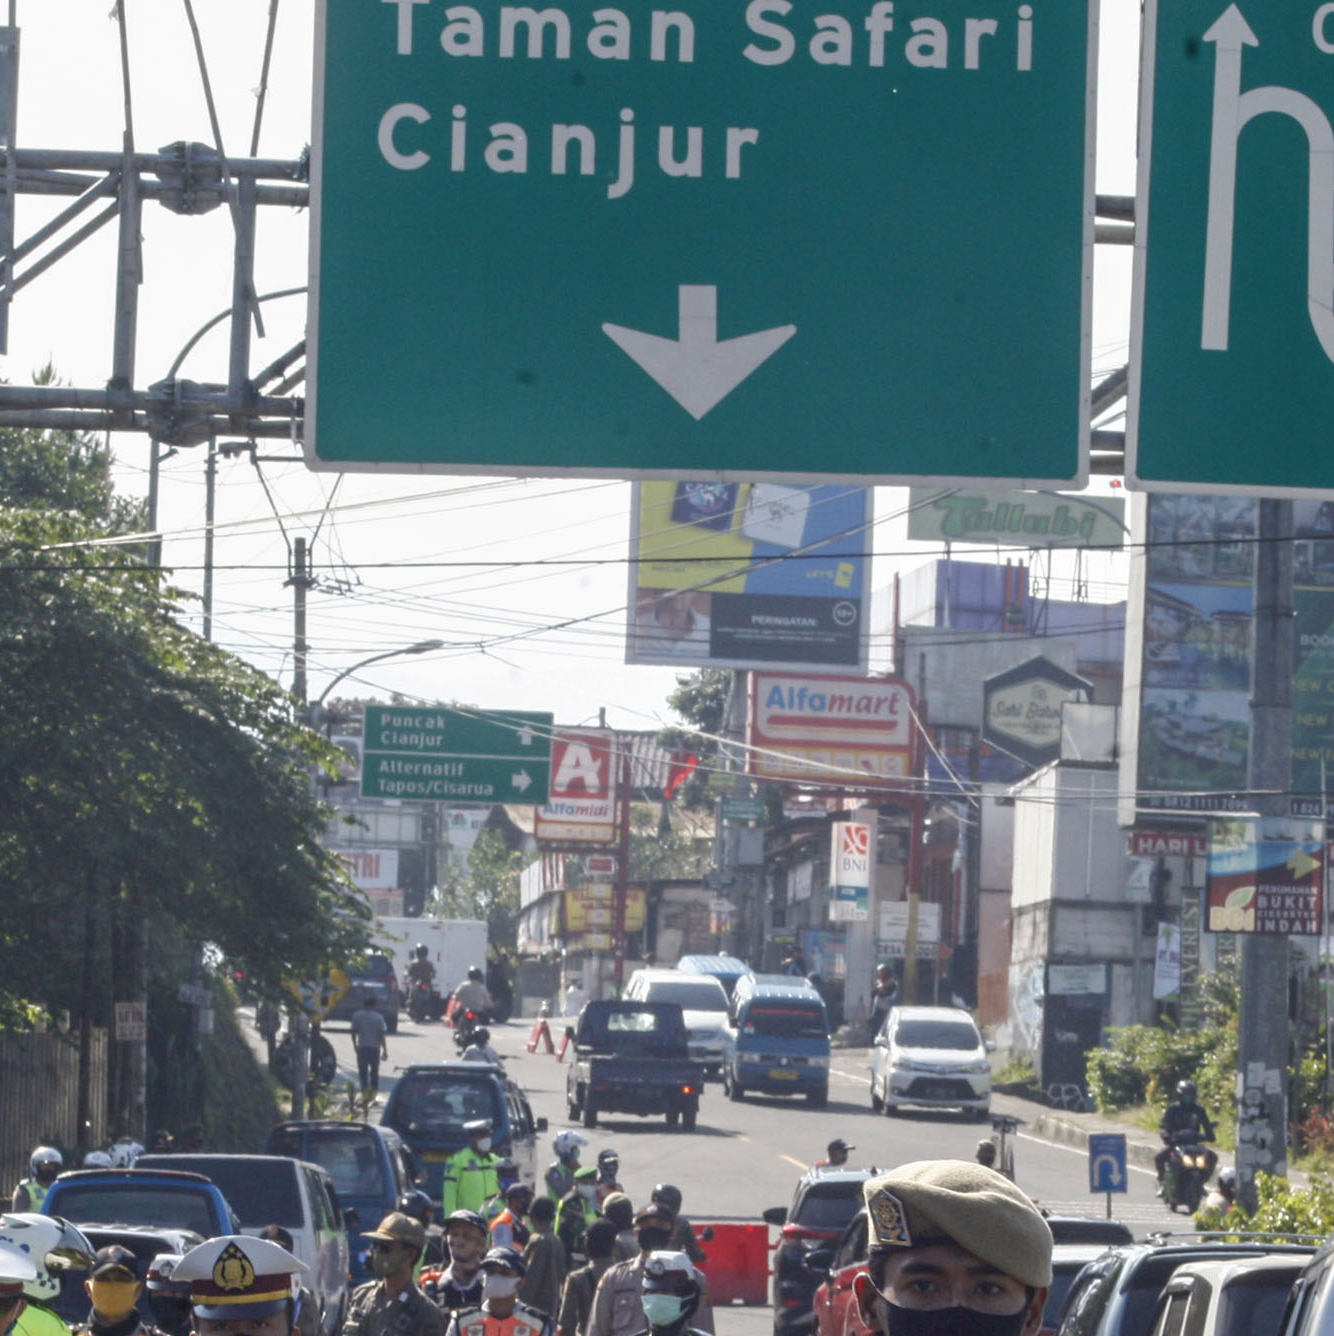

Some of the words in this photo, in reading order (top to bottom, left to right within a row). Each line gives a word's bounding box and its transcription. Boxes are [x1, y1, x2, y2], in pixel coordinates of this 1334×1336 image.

[381, 0, 697, 64] Taman
[742, 0, 1034, 72] Safari
[377, 102, 760, 200] Cianjur
[766, 684, 901, 718] Alfamart
[380, 713, 445, 730] Puncak
[380, 730, 444, 749] Cianjur
[378, 759, 466, 777] Alternatif
[378, 779, 495, 797] Tapos/Cisarua
[1138, 836, 1189, 854] HARI
[842, 858, 867, 873] BNI
[1257, 895, 1318, 908] BUKIT
[1257, 919, 1318, 933] INDAH
